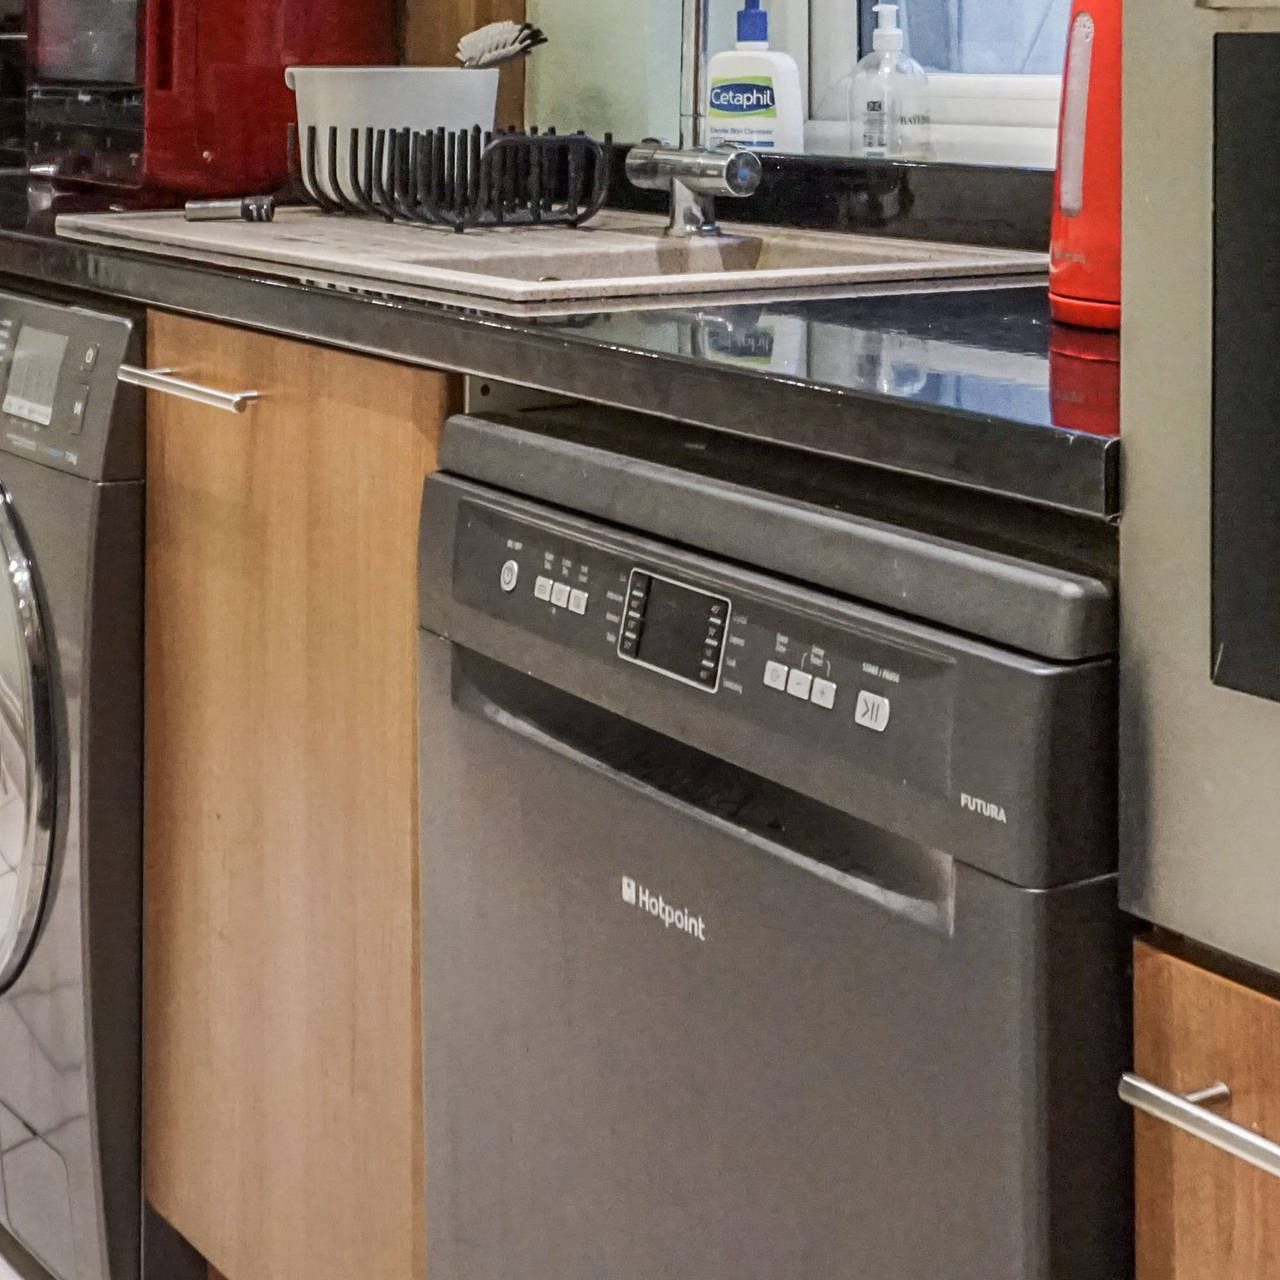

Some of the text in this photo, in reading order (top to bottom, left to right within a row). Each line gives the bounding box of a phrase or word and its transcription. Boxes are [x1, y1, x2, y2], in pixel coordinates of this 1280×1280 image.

[711, 88, 773, 109] Cetaphil
[960, 792, 1007, 824] FUTURA
[638, 885, 706, 941] Hotpoint
